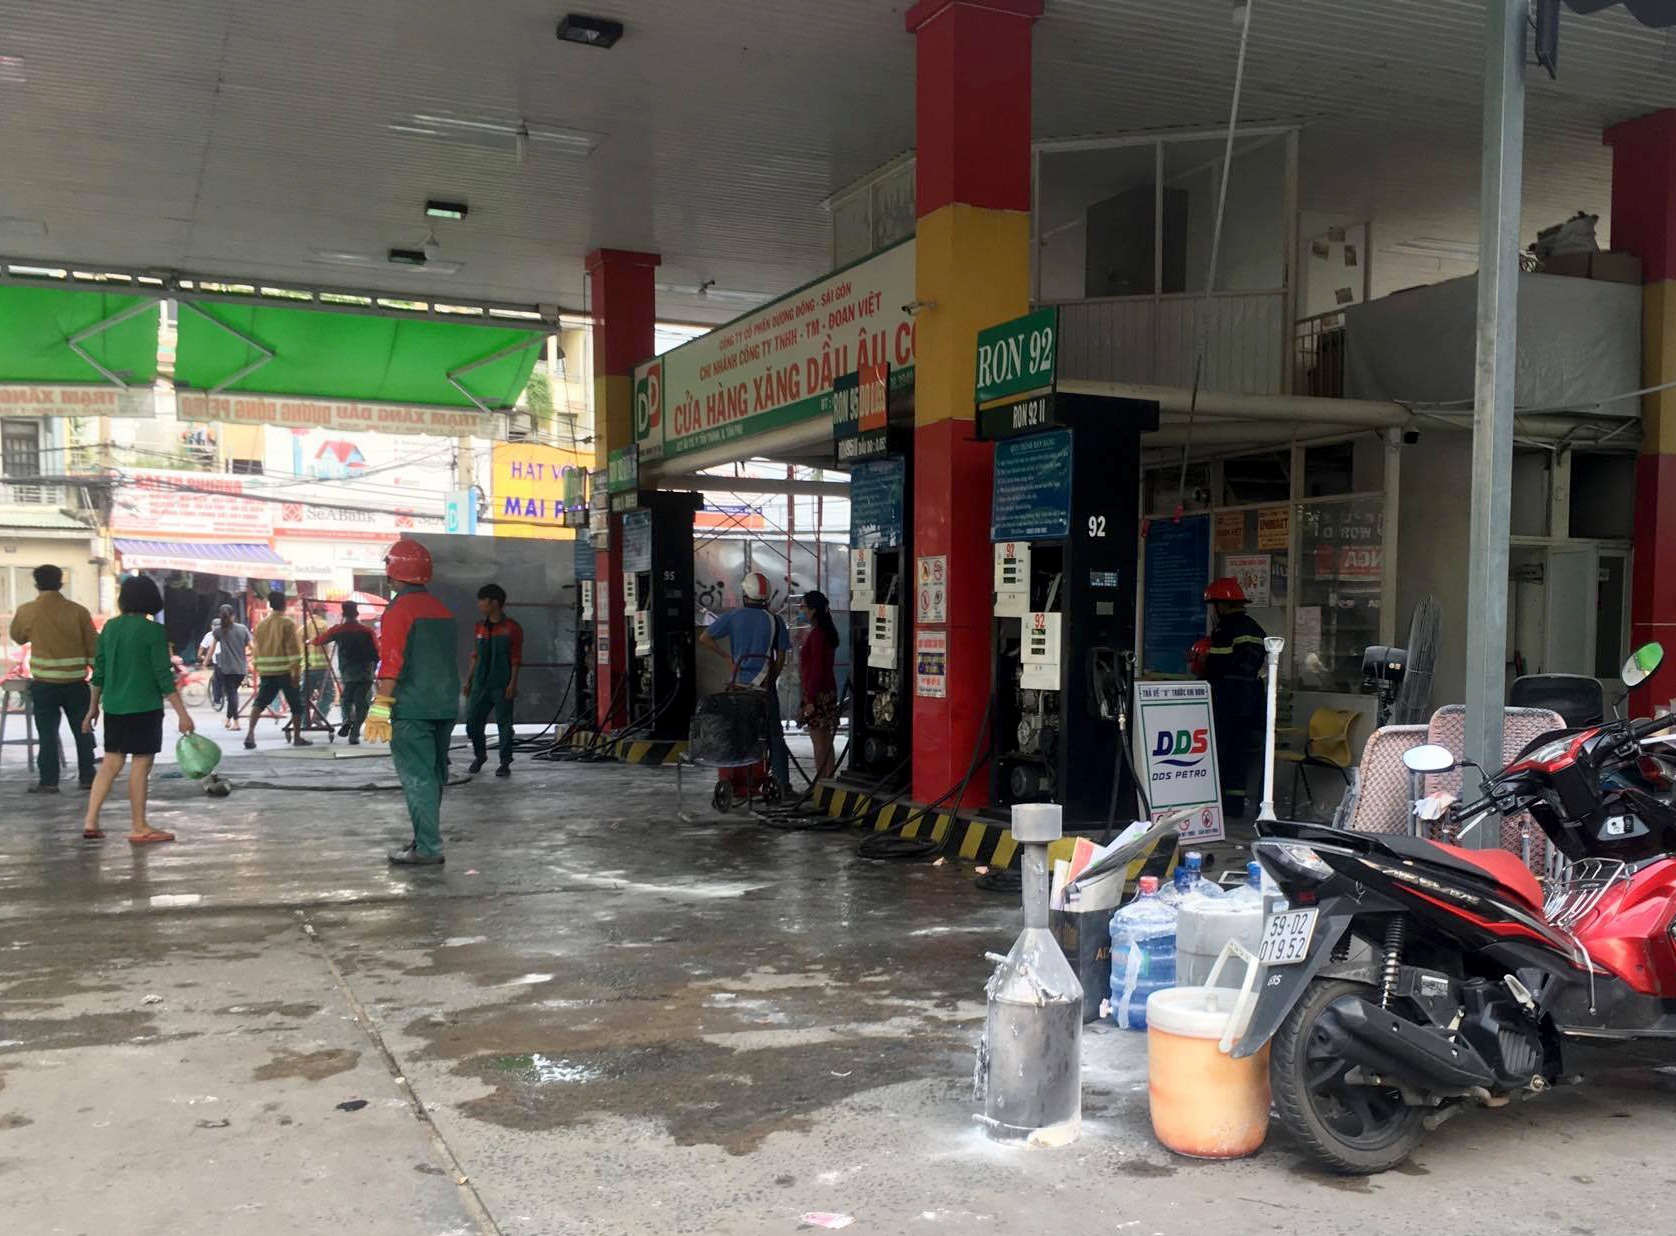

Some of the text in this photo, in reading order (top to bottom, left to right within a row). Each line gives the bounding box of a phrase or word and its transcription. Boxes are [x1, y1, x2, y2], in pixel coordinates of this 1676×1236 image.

[805, 317, 820, 342] TM
[978, 327, 1053, 388] RON 92
[674, 390, 702, 436] CỬA
[706, 381, 749, 427] HÀNG
[753, 364, 802, 413] XĂNG
[806, 334, 848, 393] DẦU
[1013, 406, 1027, 429] RON
[1028, 402, 1038, 426] 92
[505, 496, 544, 518] MAI
[1088, 515, 1107, 538] 92
[1006, 543, 1015, 558] 92
[664, 571, 675, 581] 95
[1034, 614, 1046, 628] 92
[1152, 728, 1208, 756] DDS
[1152, 769, 1207, 782] DDS PETRO
[1270, 913, 1308, 937] 59-D2
